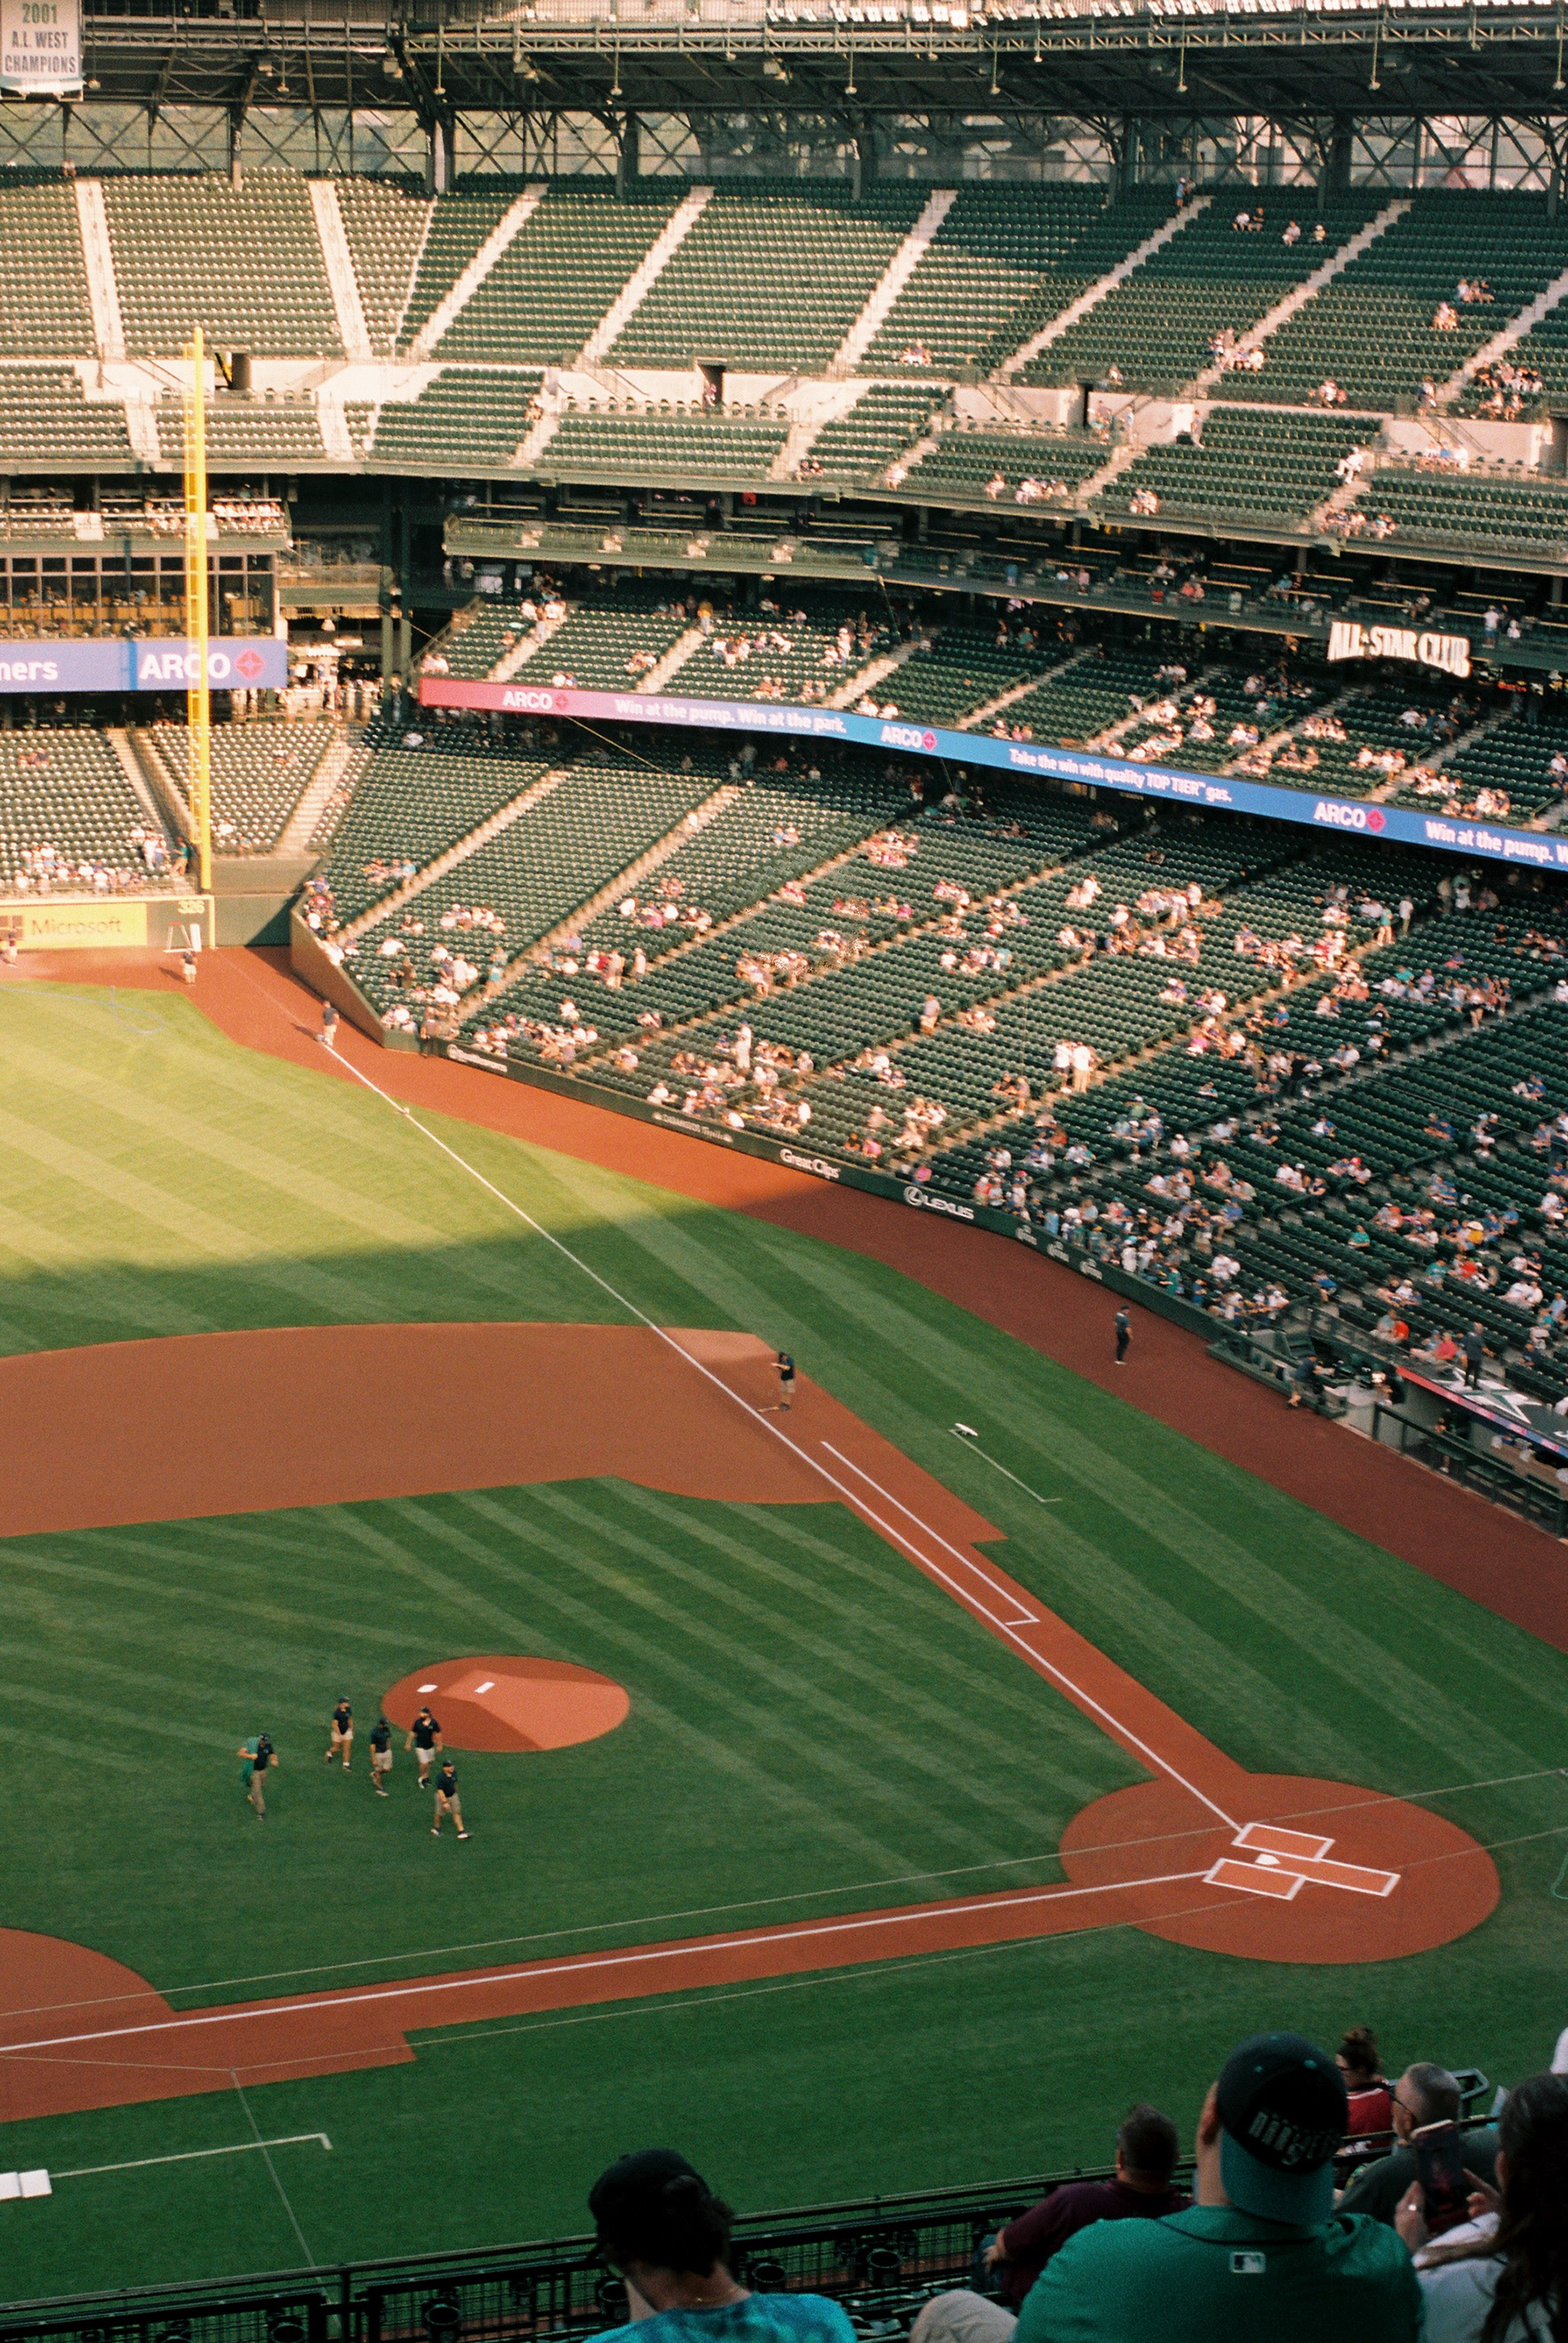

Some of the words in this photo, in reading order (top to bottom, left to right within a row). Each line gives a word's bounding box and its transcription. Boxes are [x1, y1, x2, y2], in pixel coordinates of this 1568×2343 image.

[23, 3, 57, 24] 2001
[12, 30, 32, 48] A.L.
[35, 31, 68, 48] WEST
[5, 55, 76, 73] CHAMPIONS
[139, 653, 231, 679] ARCO
[1419, 632, 1471, 678] CLUB
[502, 691, 553, 710] ARCO
[615, 699, 644, 715] Win
[646, 702, 661, 716] at
[662, 703, 687, 718] the
[688, 707, 735, 725] pump.
[737, 707, 767, 724] Win
[768, 712, 784, 727] at
[786, 712, 812, 728] the
[880, 725, 923, 748] ARCO
[1009, 748, 1037, 767] Take
[1037, 754, 1058, 770] the
[1079, 762, 1104, 778] with
[1103, 768, 1145, 789] quality
[1145, 773, 1171, 790] TOP
[1313, 802, 1366, 828] ARCO
[1425, 821, 1456, 843] Win
[1457, 830, 1474, 847] at
[1476, 831, 1502, 852] the
[1503, 840, 1553, 863] pump.
[31, 916, 122, 935] Microsoft
[780, 1148, 813, 1170] Great
[923, 1195, 974, 1220] LEXUS
